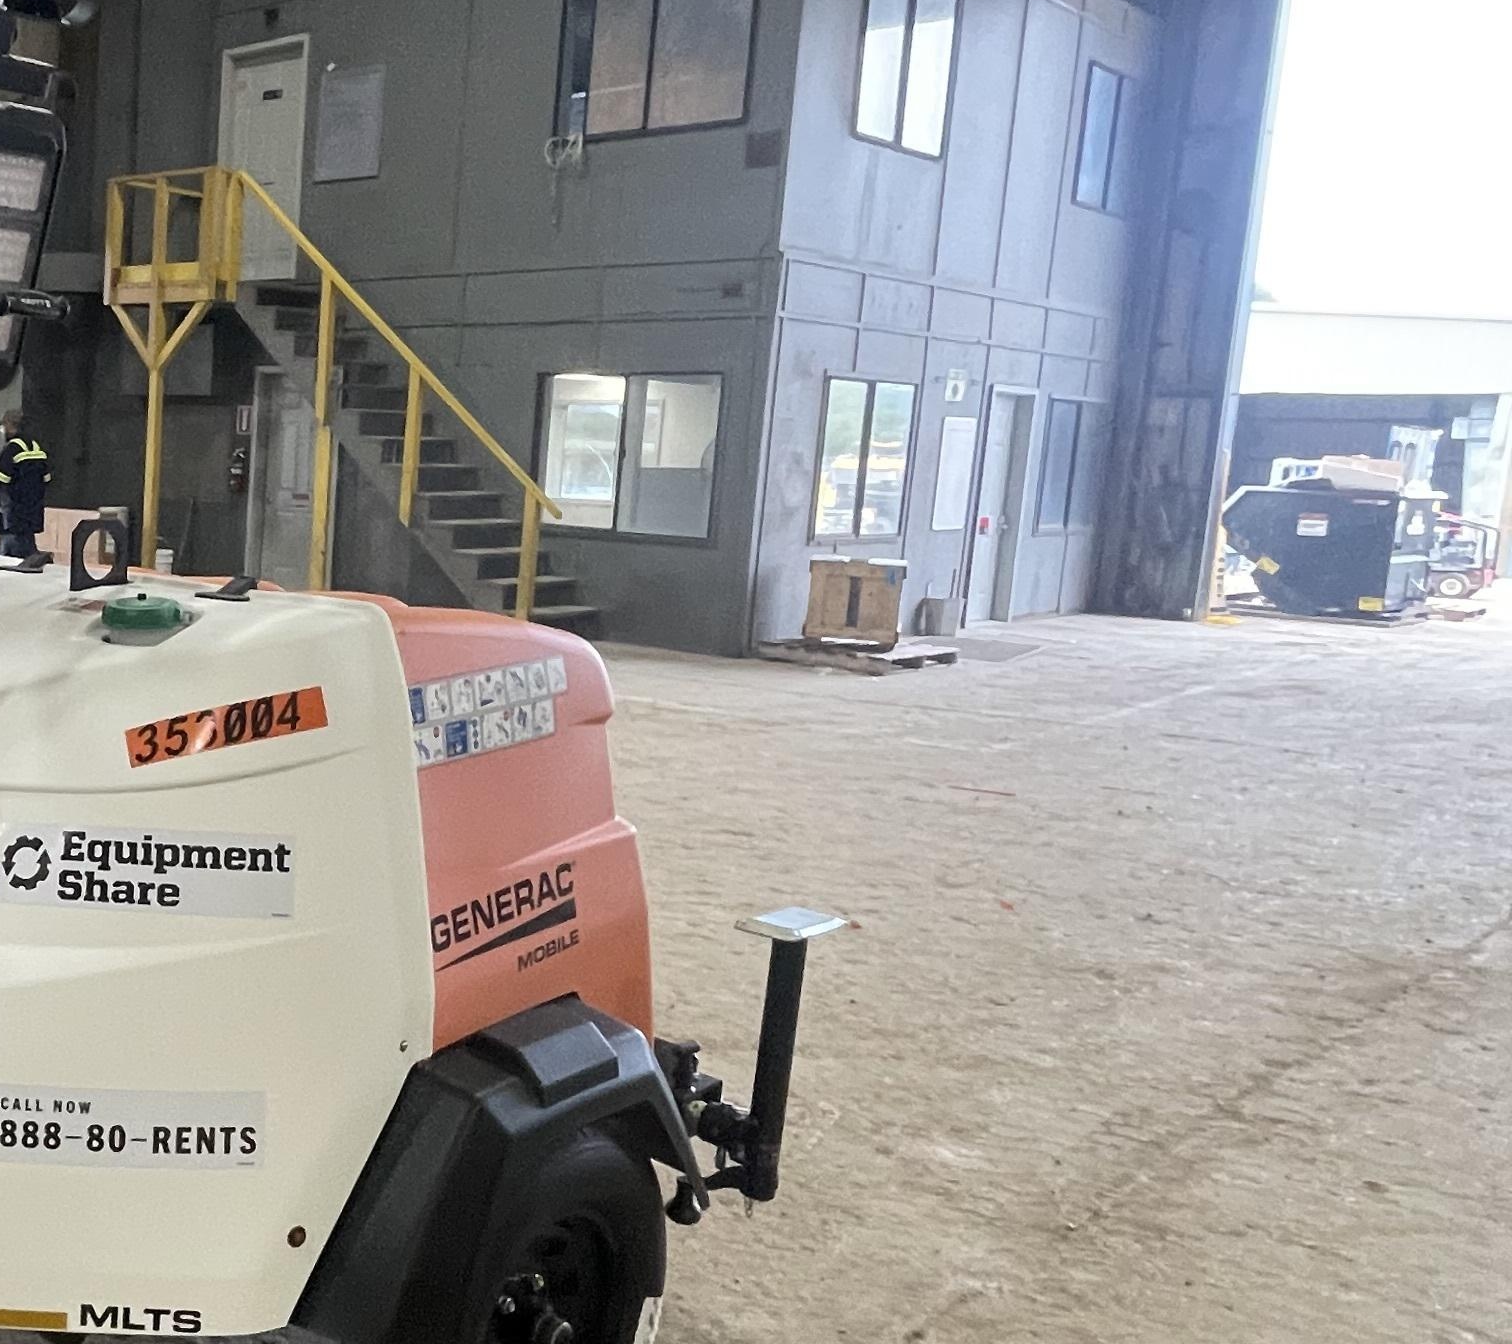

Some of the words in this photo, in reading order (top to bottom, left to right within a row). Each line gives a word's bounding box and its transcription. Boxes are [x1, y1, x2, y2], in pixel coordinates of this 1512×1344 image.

[60, 830, 291, 875] Equipment
[57, 869, 181, 906] Share
[430, 862, 575, 953] GENERAC
[517, 928, 580, 972] MOBILE
[0, 1096, 44, 1113] CALL
[52, 1099, 92, 1115] NOW
[0, 1119, 257, 1155] 888-80-RENTS
[79, 1303, 202, 1334] MLTS
